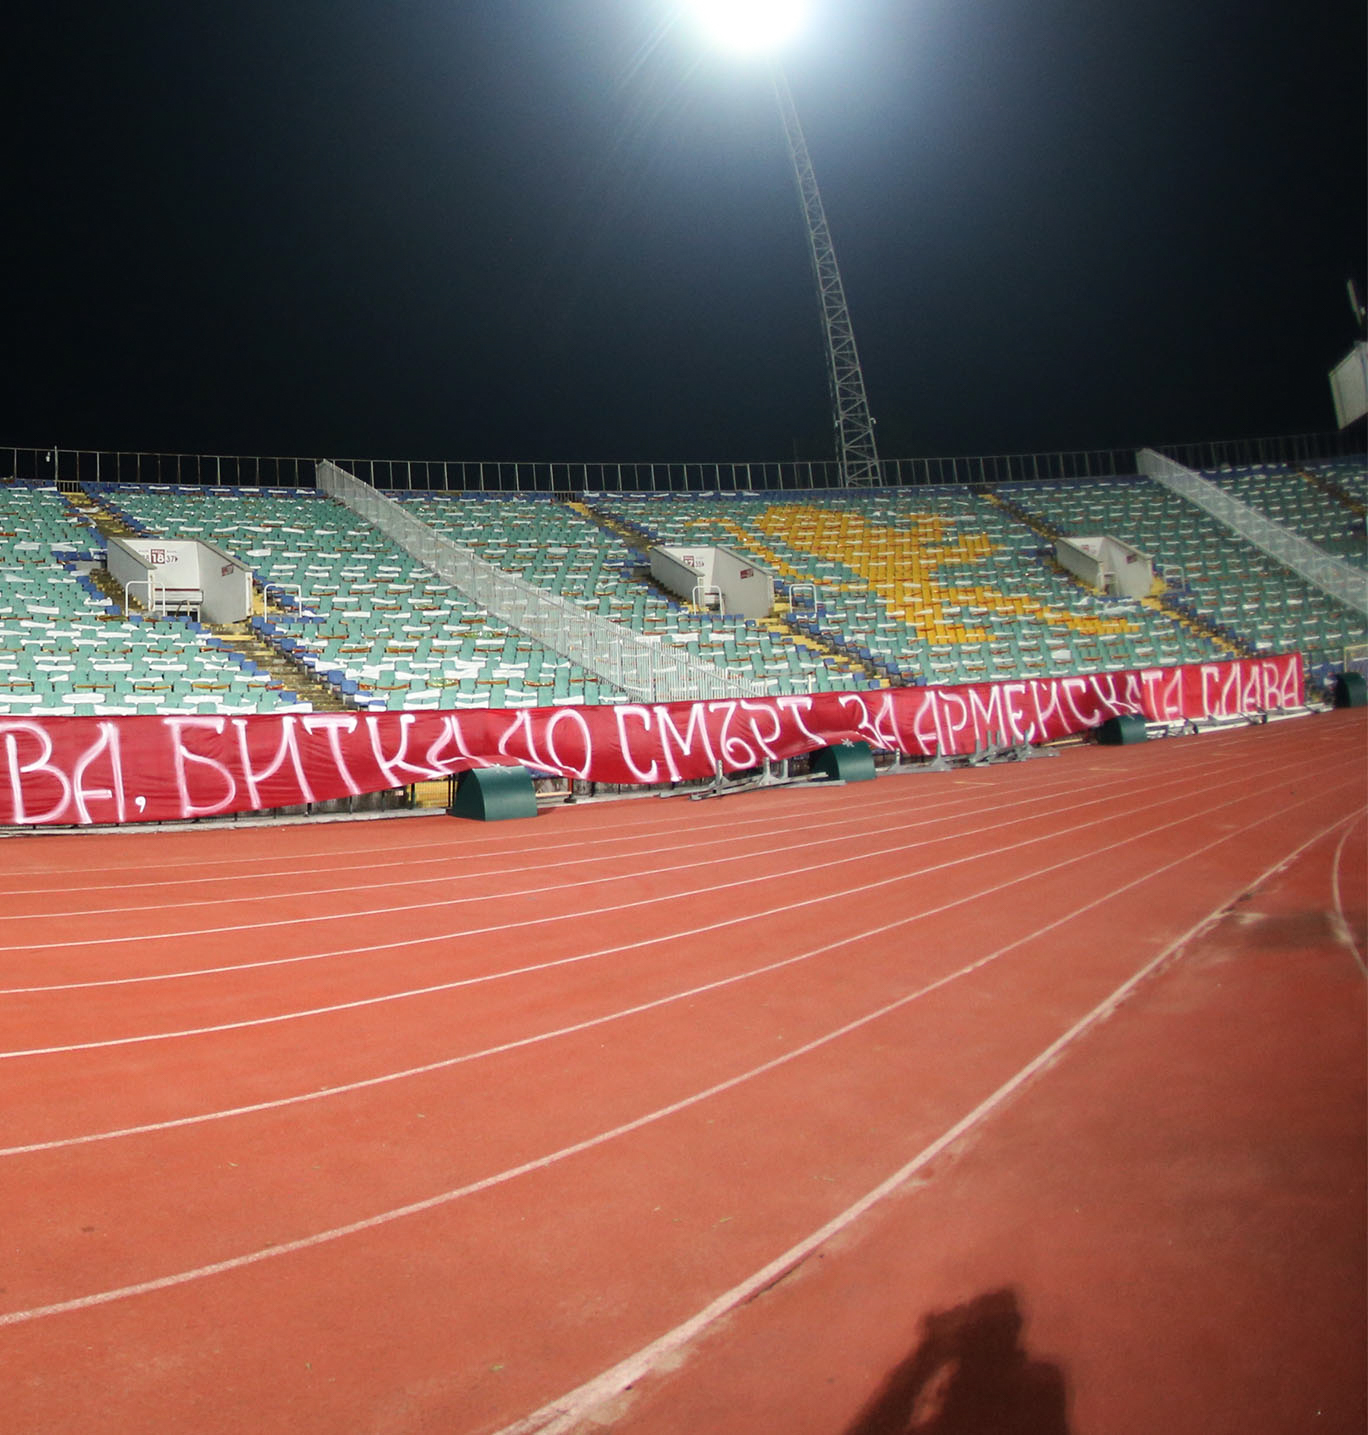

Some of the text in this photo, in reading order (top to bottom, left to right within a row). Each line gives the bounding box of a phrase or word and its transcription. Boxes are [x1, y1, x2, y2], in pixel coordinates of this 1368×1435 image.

[152, 553, 165, 564] 18
[163, 713, 497, 816] БИТКА
[613, 696, 827, 783] СМЪРТ
[838, 692, 909, 753] ЗА
[1200, 656, 1300, 720] СЛАВА
